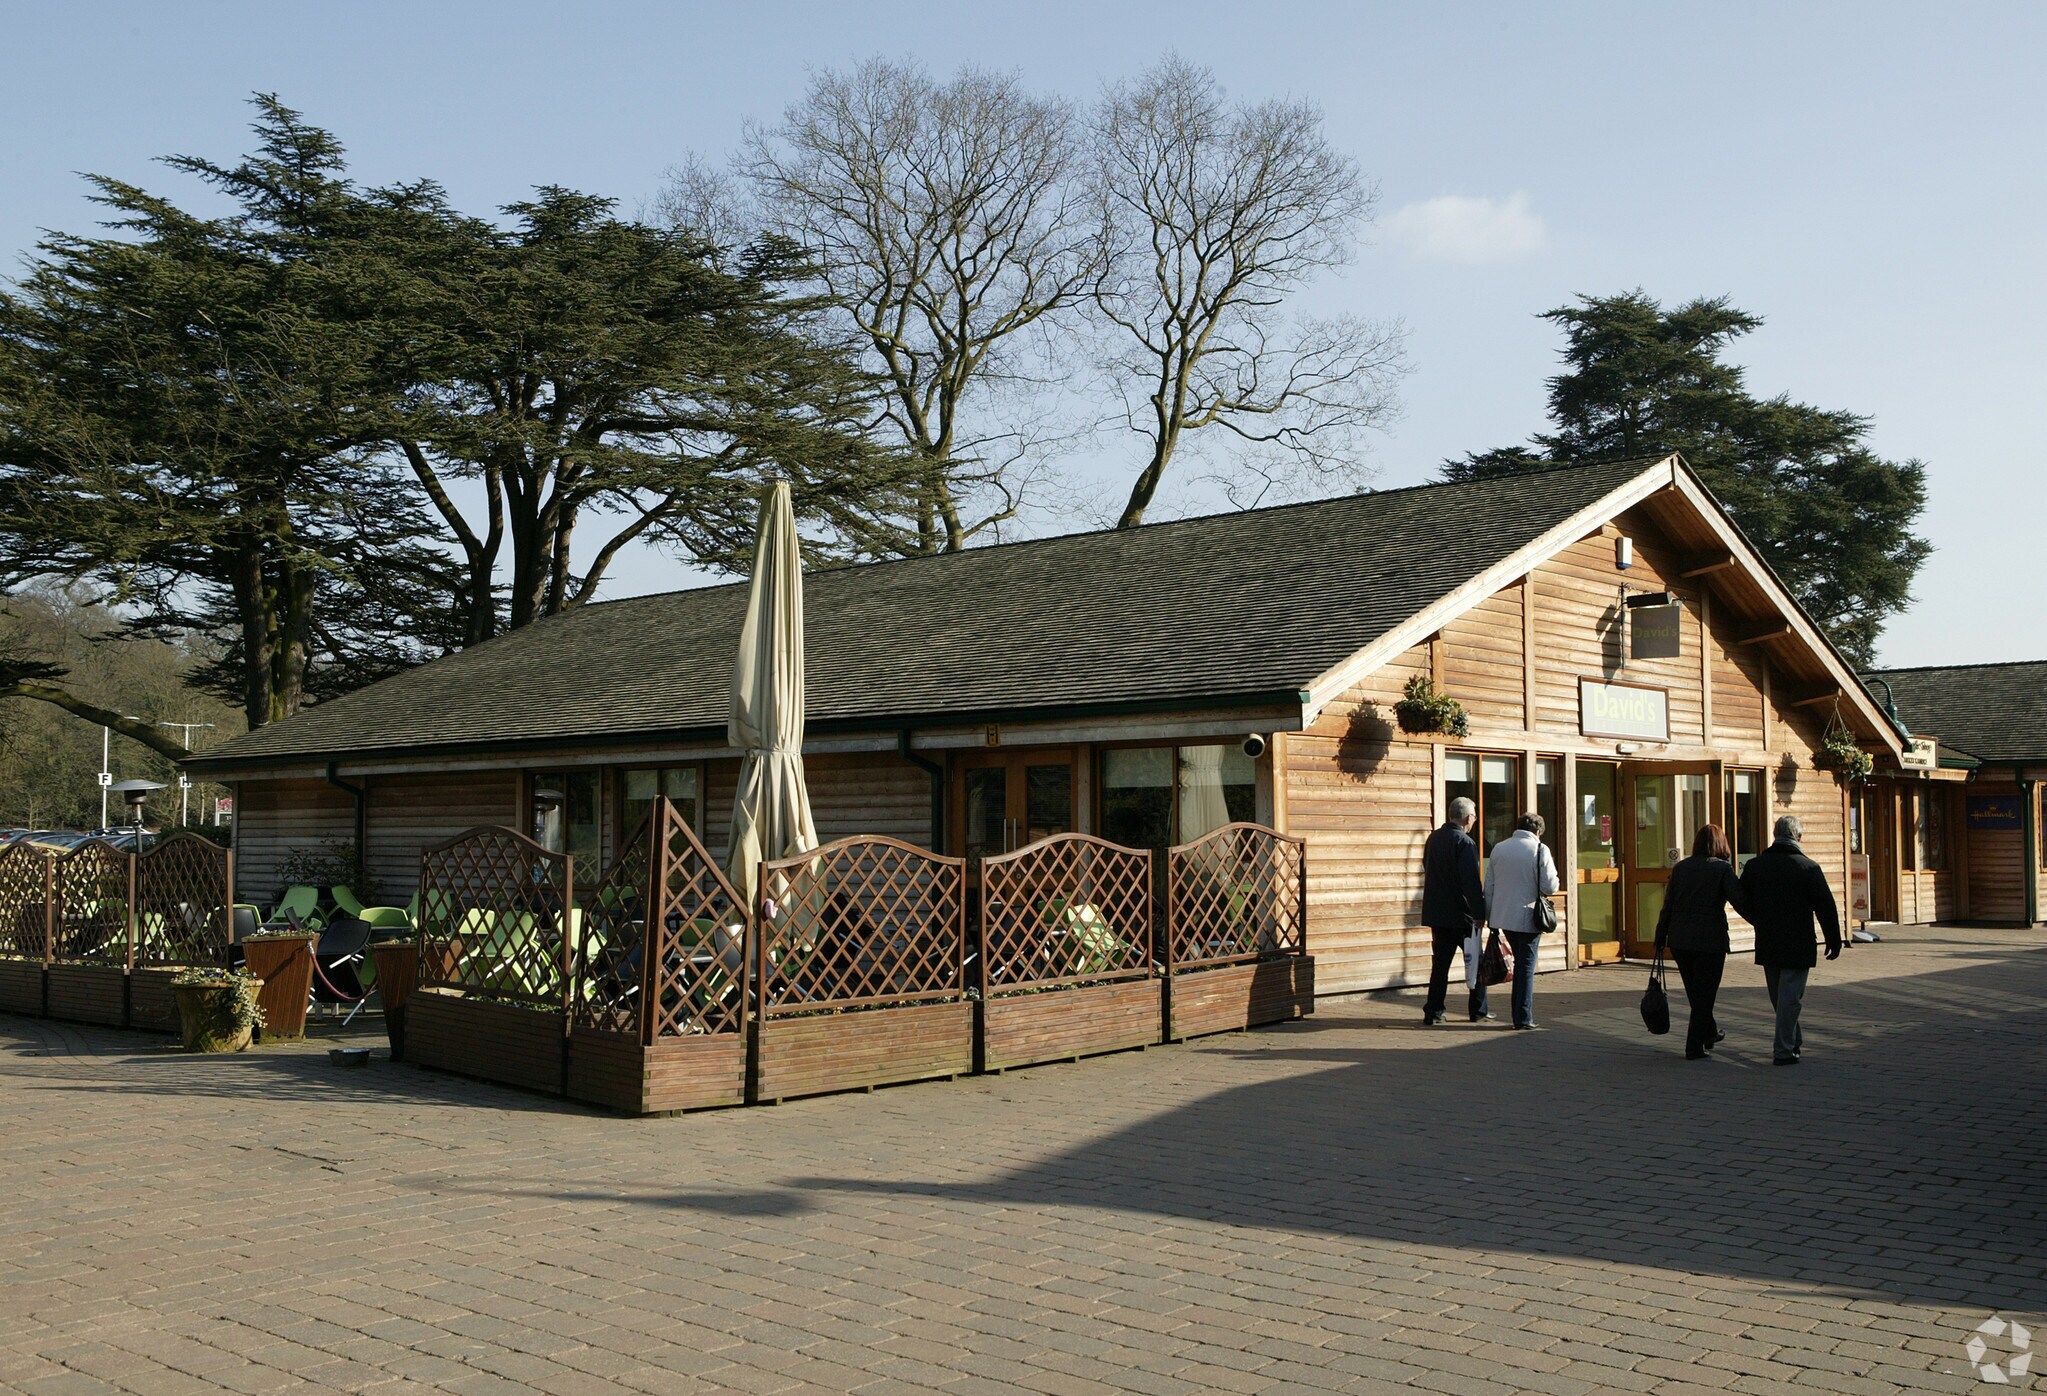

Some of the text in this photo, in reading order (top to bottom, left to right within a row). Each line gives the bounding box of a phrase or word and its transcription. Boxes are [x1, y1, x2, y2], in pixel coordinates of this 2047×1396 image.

[1633, 624, 1677, 639] David's
[1593, 686, 1656, 722] David's
[102, 775, 109, 784] F
[1970, 808, 2017, 823] Hallmark
